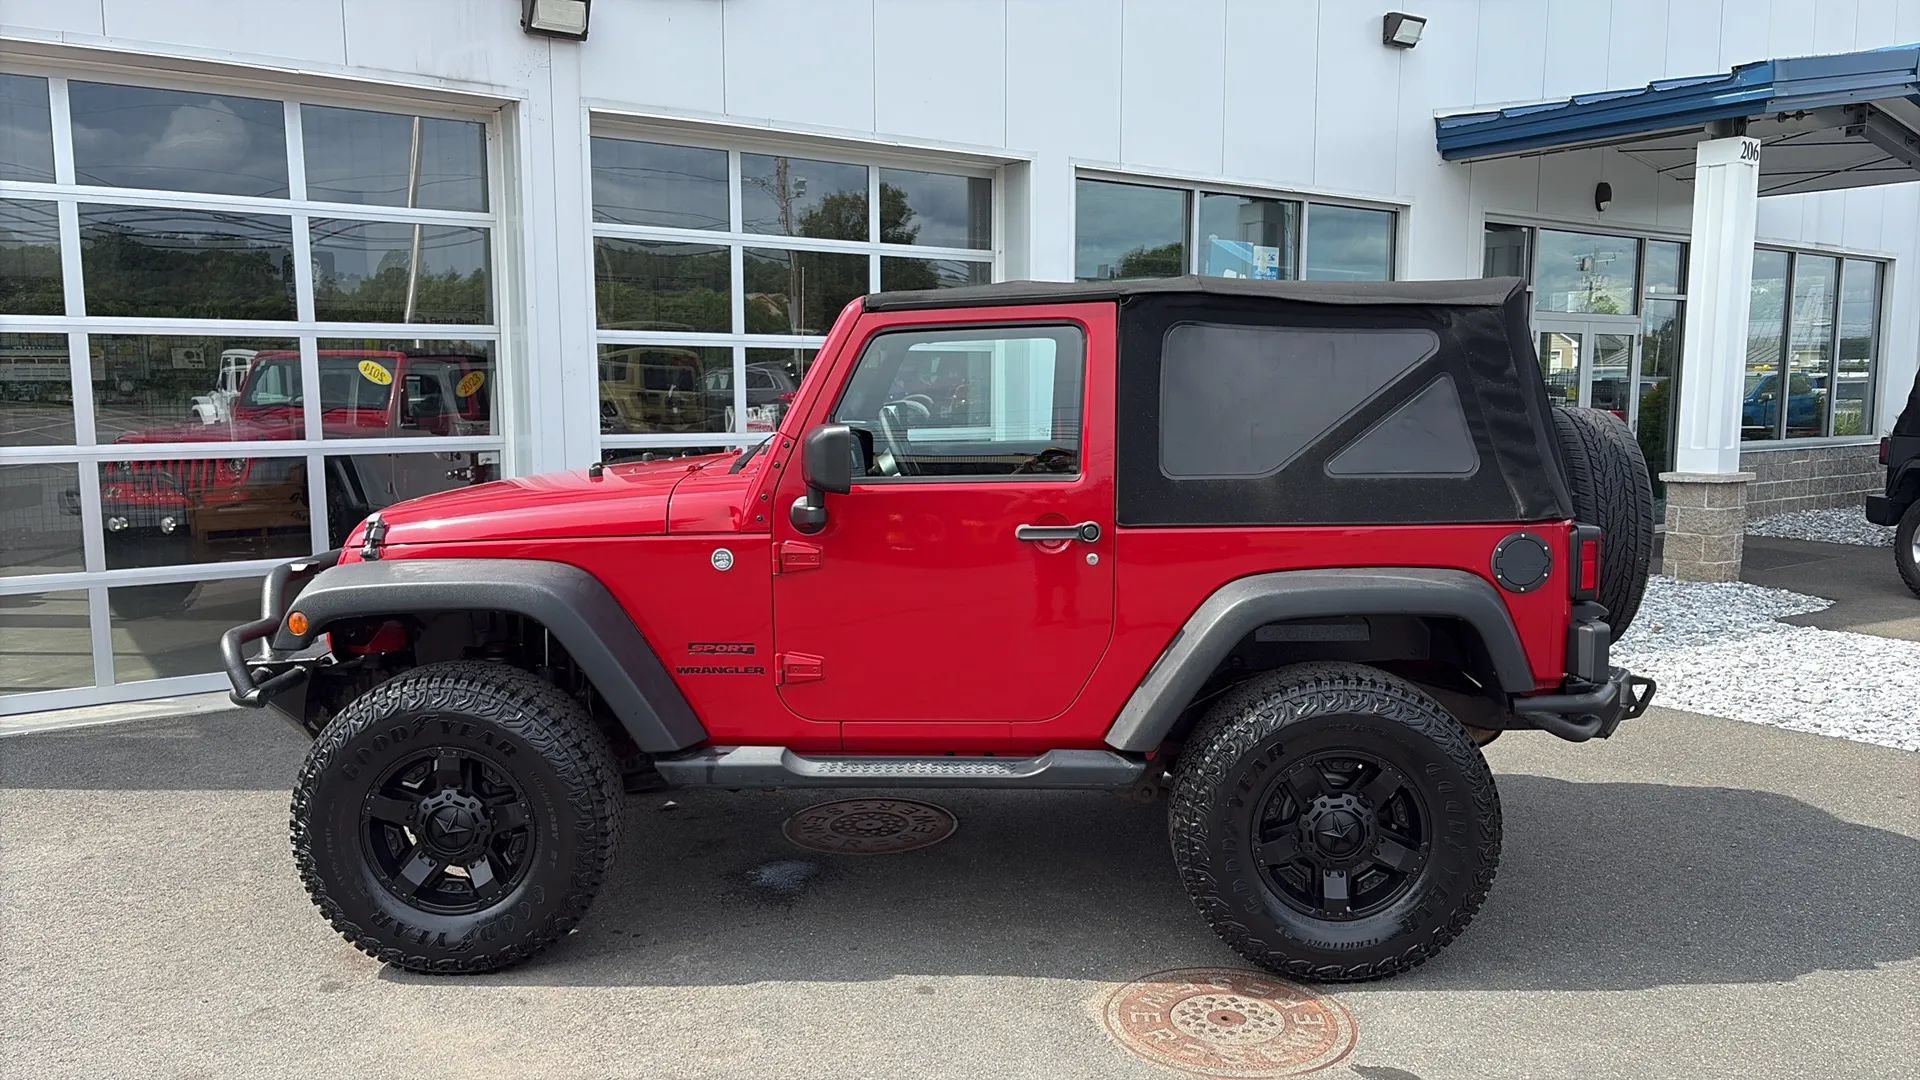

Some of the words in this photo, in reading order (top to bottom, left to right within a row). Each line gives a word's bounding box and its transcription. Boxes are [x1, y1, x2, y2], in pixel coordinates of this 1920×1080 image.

[1740, 141, 1759, 161] 206
[688, 643, 755, 654] SPORT
[676, 666, 765, 675] WRANGLER
